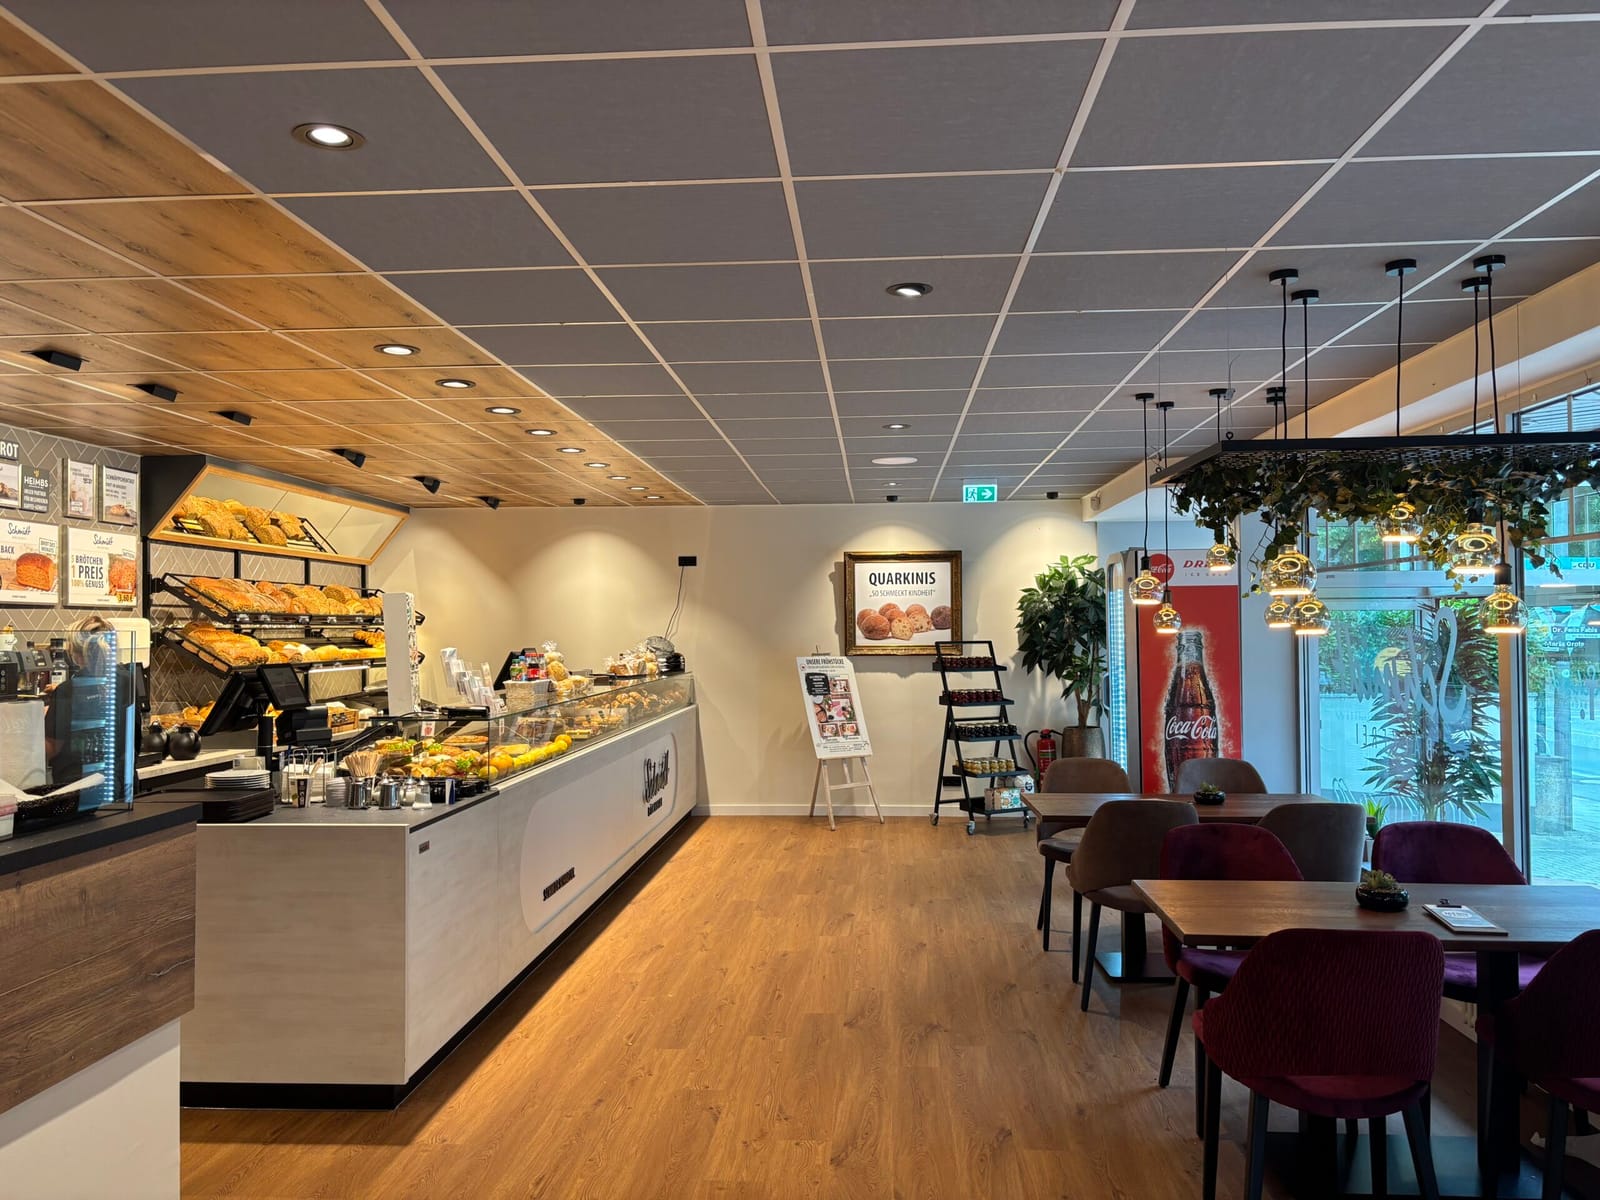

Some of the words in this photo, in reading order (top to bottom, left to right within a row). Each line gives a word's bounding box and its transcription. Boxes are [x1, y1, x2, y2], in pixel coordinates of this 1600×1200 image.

[24, 475, 49, 488] HEIMBS
[8, 522, 31, 536] Schmidt
[93, 533, 113, 546] Schmidt
[75, 553, 104, 566] BRÖTCHEN
[71, 564, 76, 579] 1
[78, 564, 104, 580] PREIS
[85, 580, 105, 589] GENUSS
[869, 571, 937, 587] QUARKINIS
[880, 589, 908, 597] SCHMECKT
[1165, 715, 1217, 740] Coca-Cola
